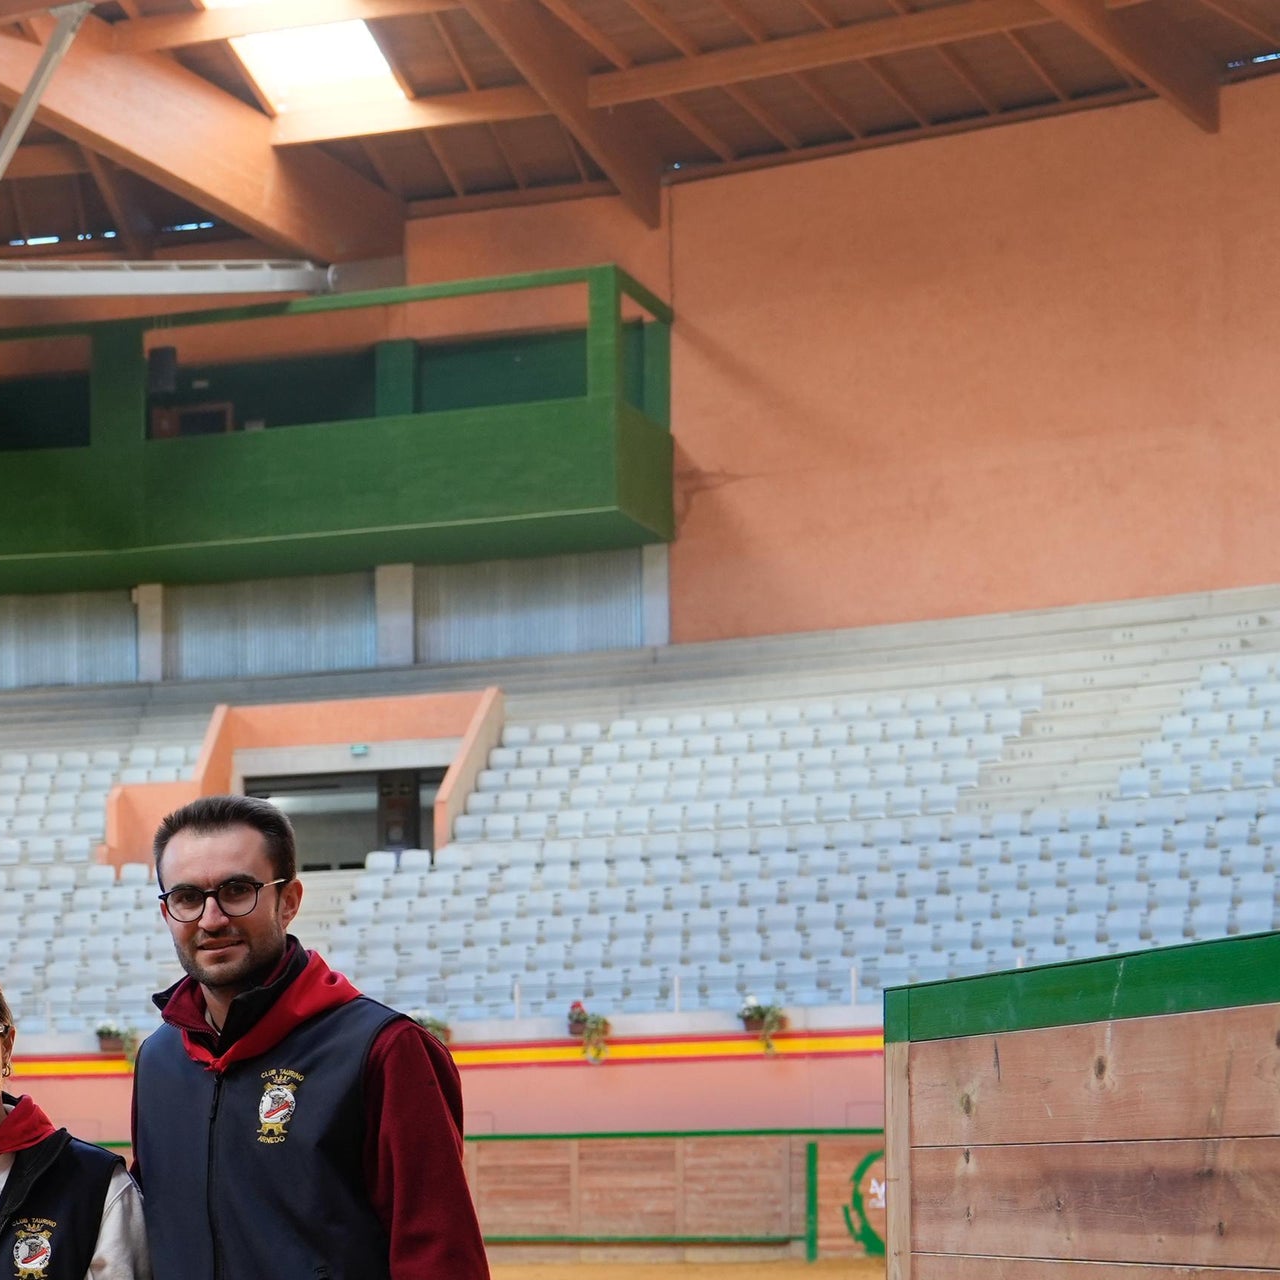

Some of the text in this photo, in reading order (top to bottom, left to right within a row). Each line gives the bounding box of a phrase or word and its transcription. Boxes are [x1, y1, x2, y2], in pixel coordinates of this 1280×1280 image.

[260, 1068, 305, 1082] CLUB TAURINO
[257, 1135, 286, 1144] ARNEDO
[31, 1217, 58, 1228] TAURINO
